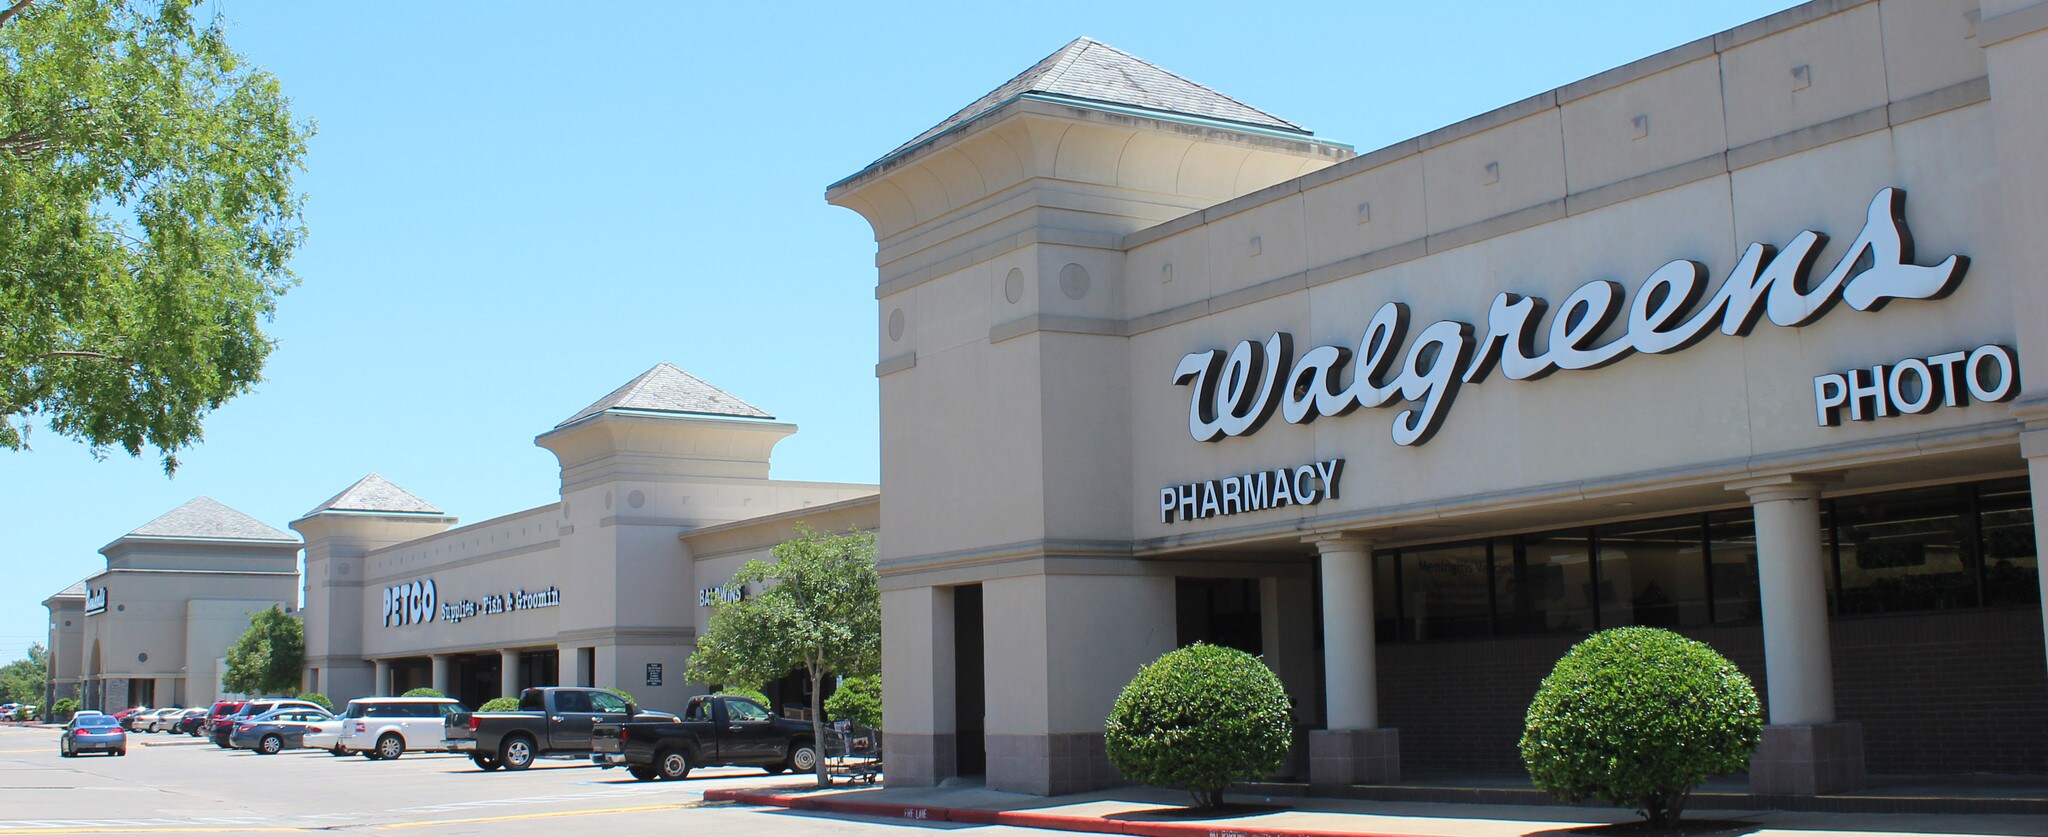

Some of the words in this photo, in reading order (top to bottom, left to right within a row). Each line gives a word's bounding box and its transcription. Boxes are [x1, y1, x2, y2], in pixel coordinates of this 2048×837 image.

[1173, 187, 1968, 446] Walgreens
[1813, 343, 2017, 427] PHOTO
[1160, 459, 1344, 524] PHARMACY
[1419, 559, 1473, 576] Meningitis
[1475, 559, 1515, 575] Vacine
[383, 578, 436, 627] PETCO
[441, 599, 476, 623] Supplies
[482, 594, 504, 615] Fish
[506, 592, 514, 612] &
[516, 586, 560, 610] Groomin
